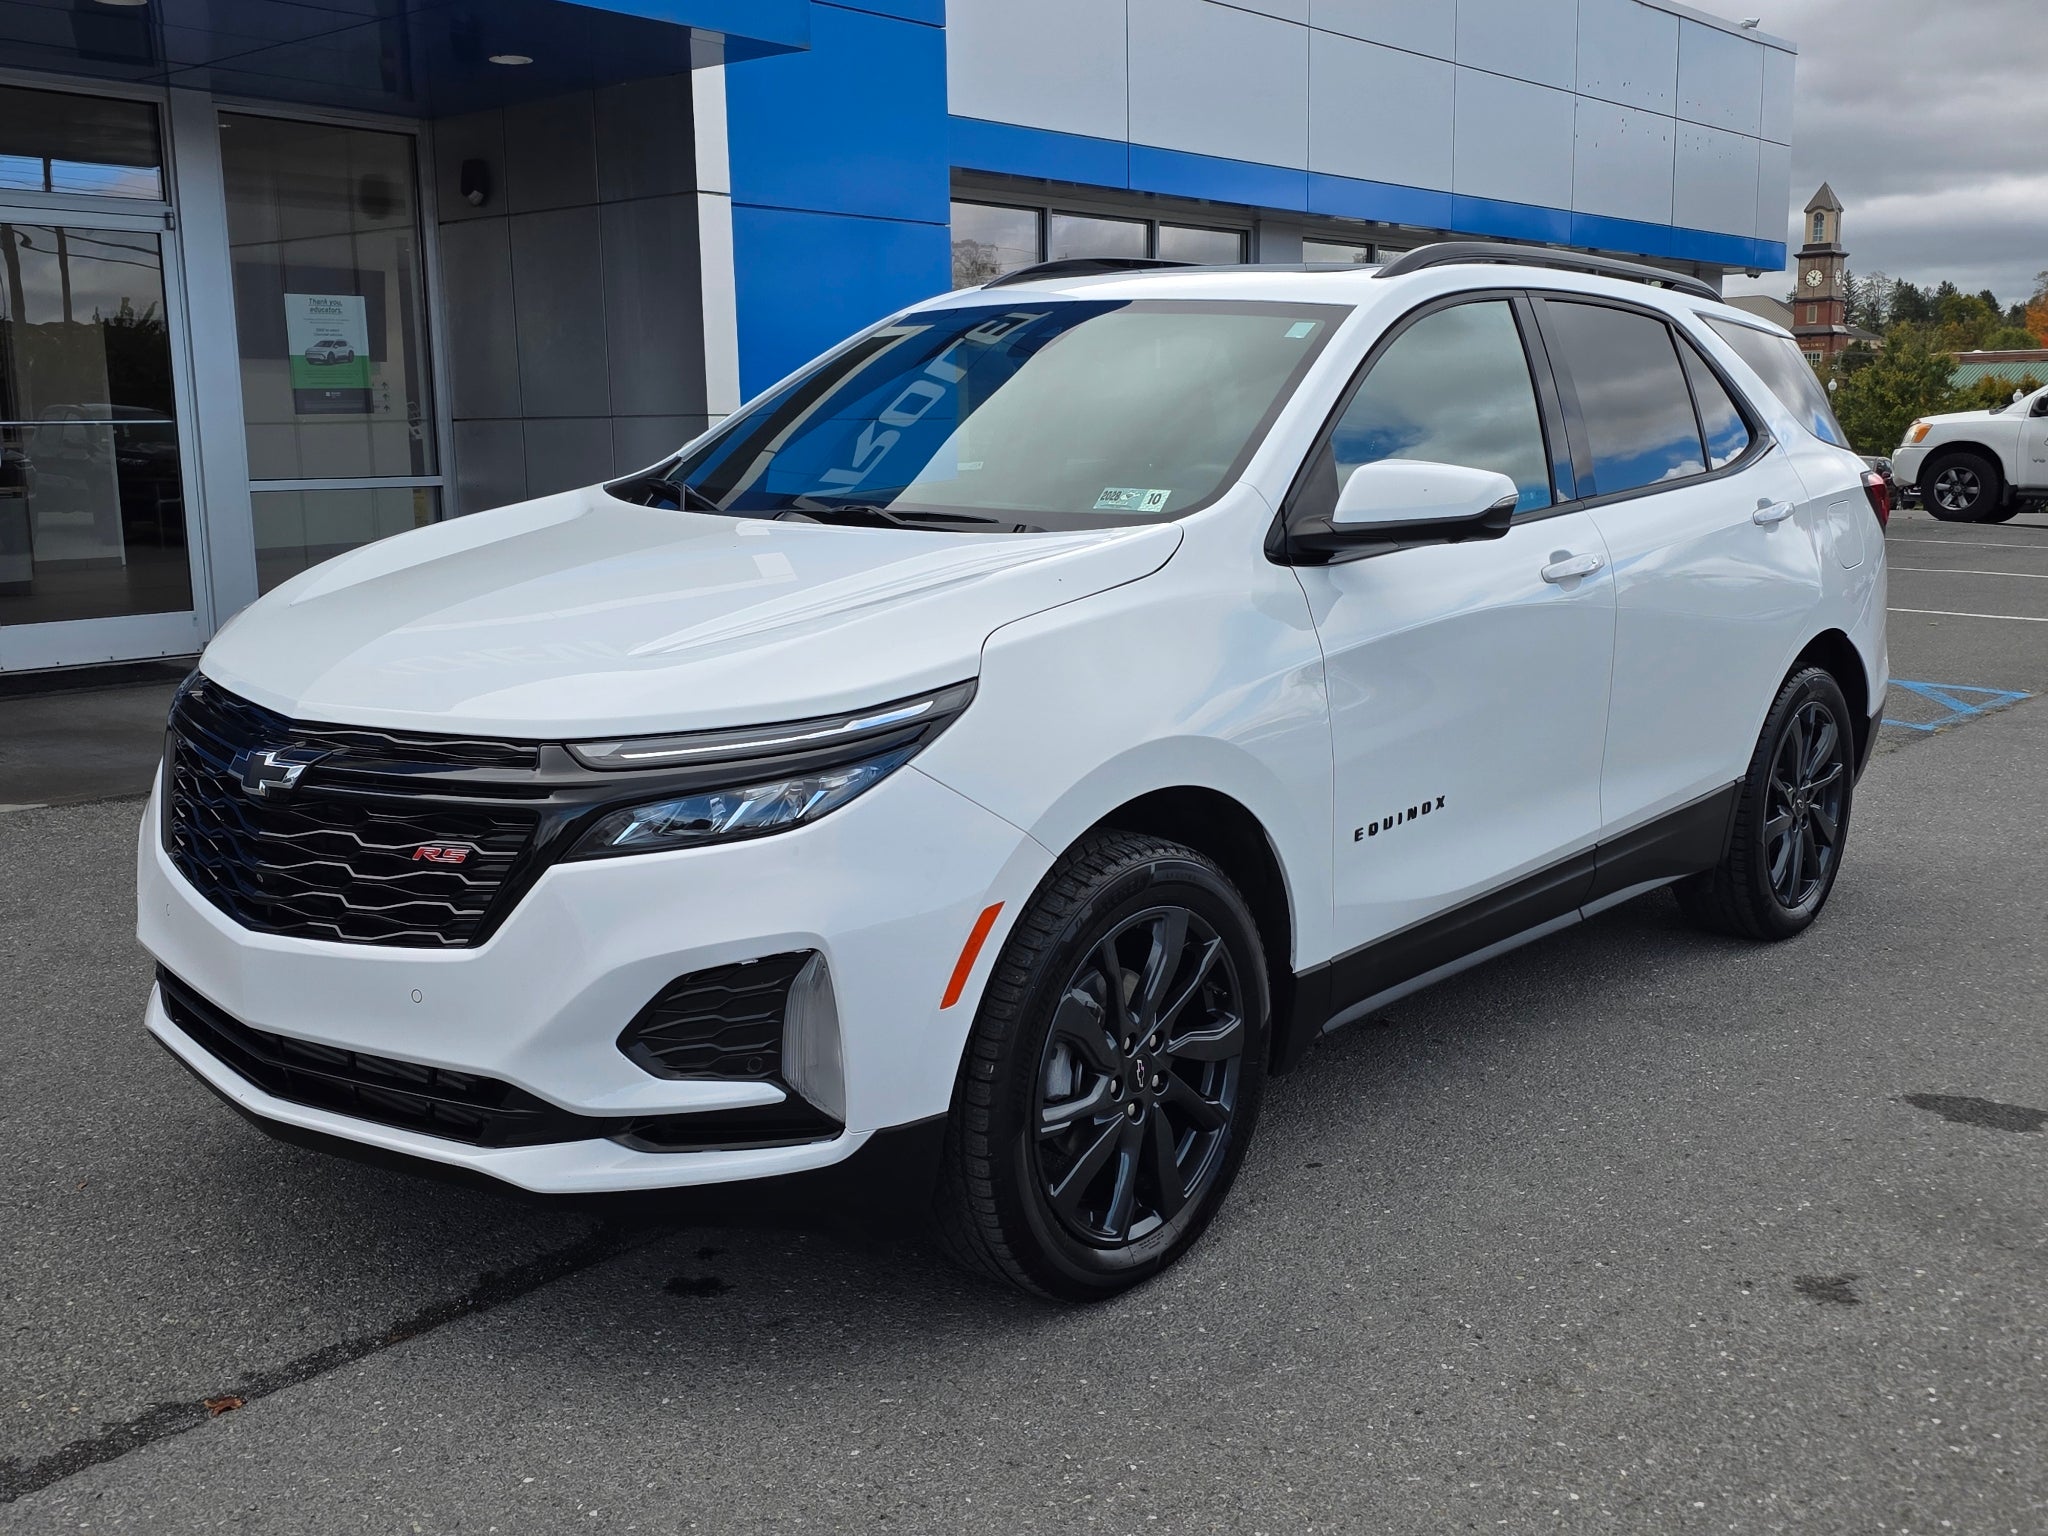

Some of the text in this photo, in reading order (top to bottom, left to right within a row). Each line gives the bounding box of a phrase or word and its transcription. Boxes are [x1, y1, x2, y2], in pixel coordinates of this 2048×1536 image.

[1147, 493, 1162, 505] 10
[1354, 795, 1445, 842] EQUINOX
[412, 846, 470, 864] RS
